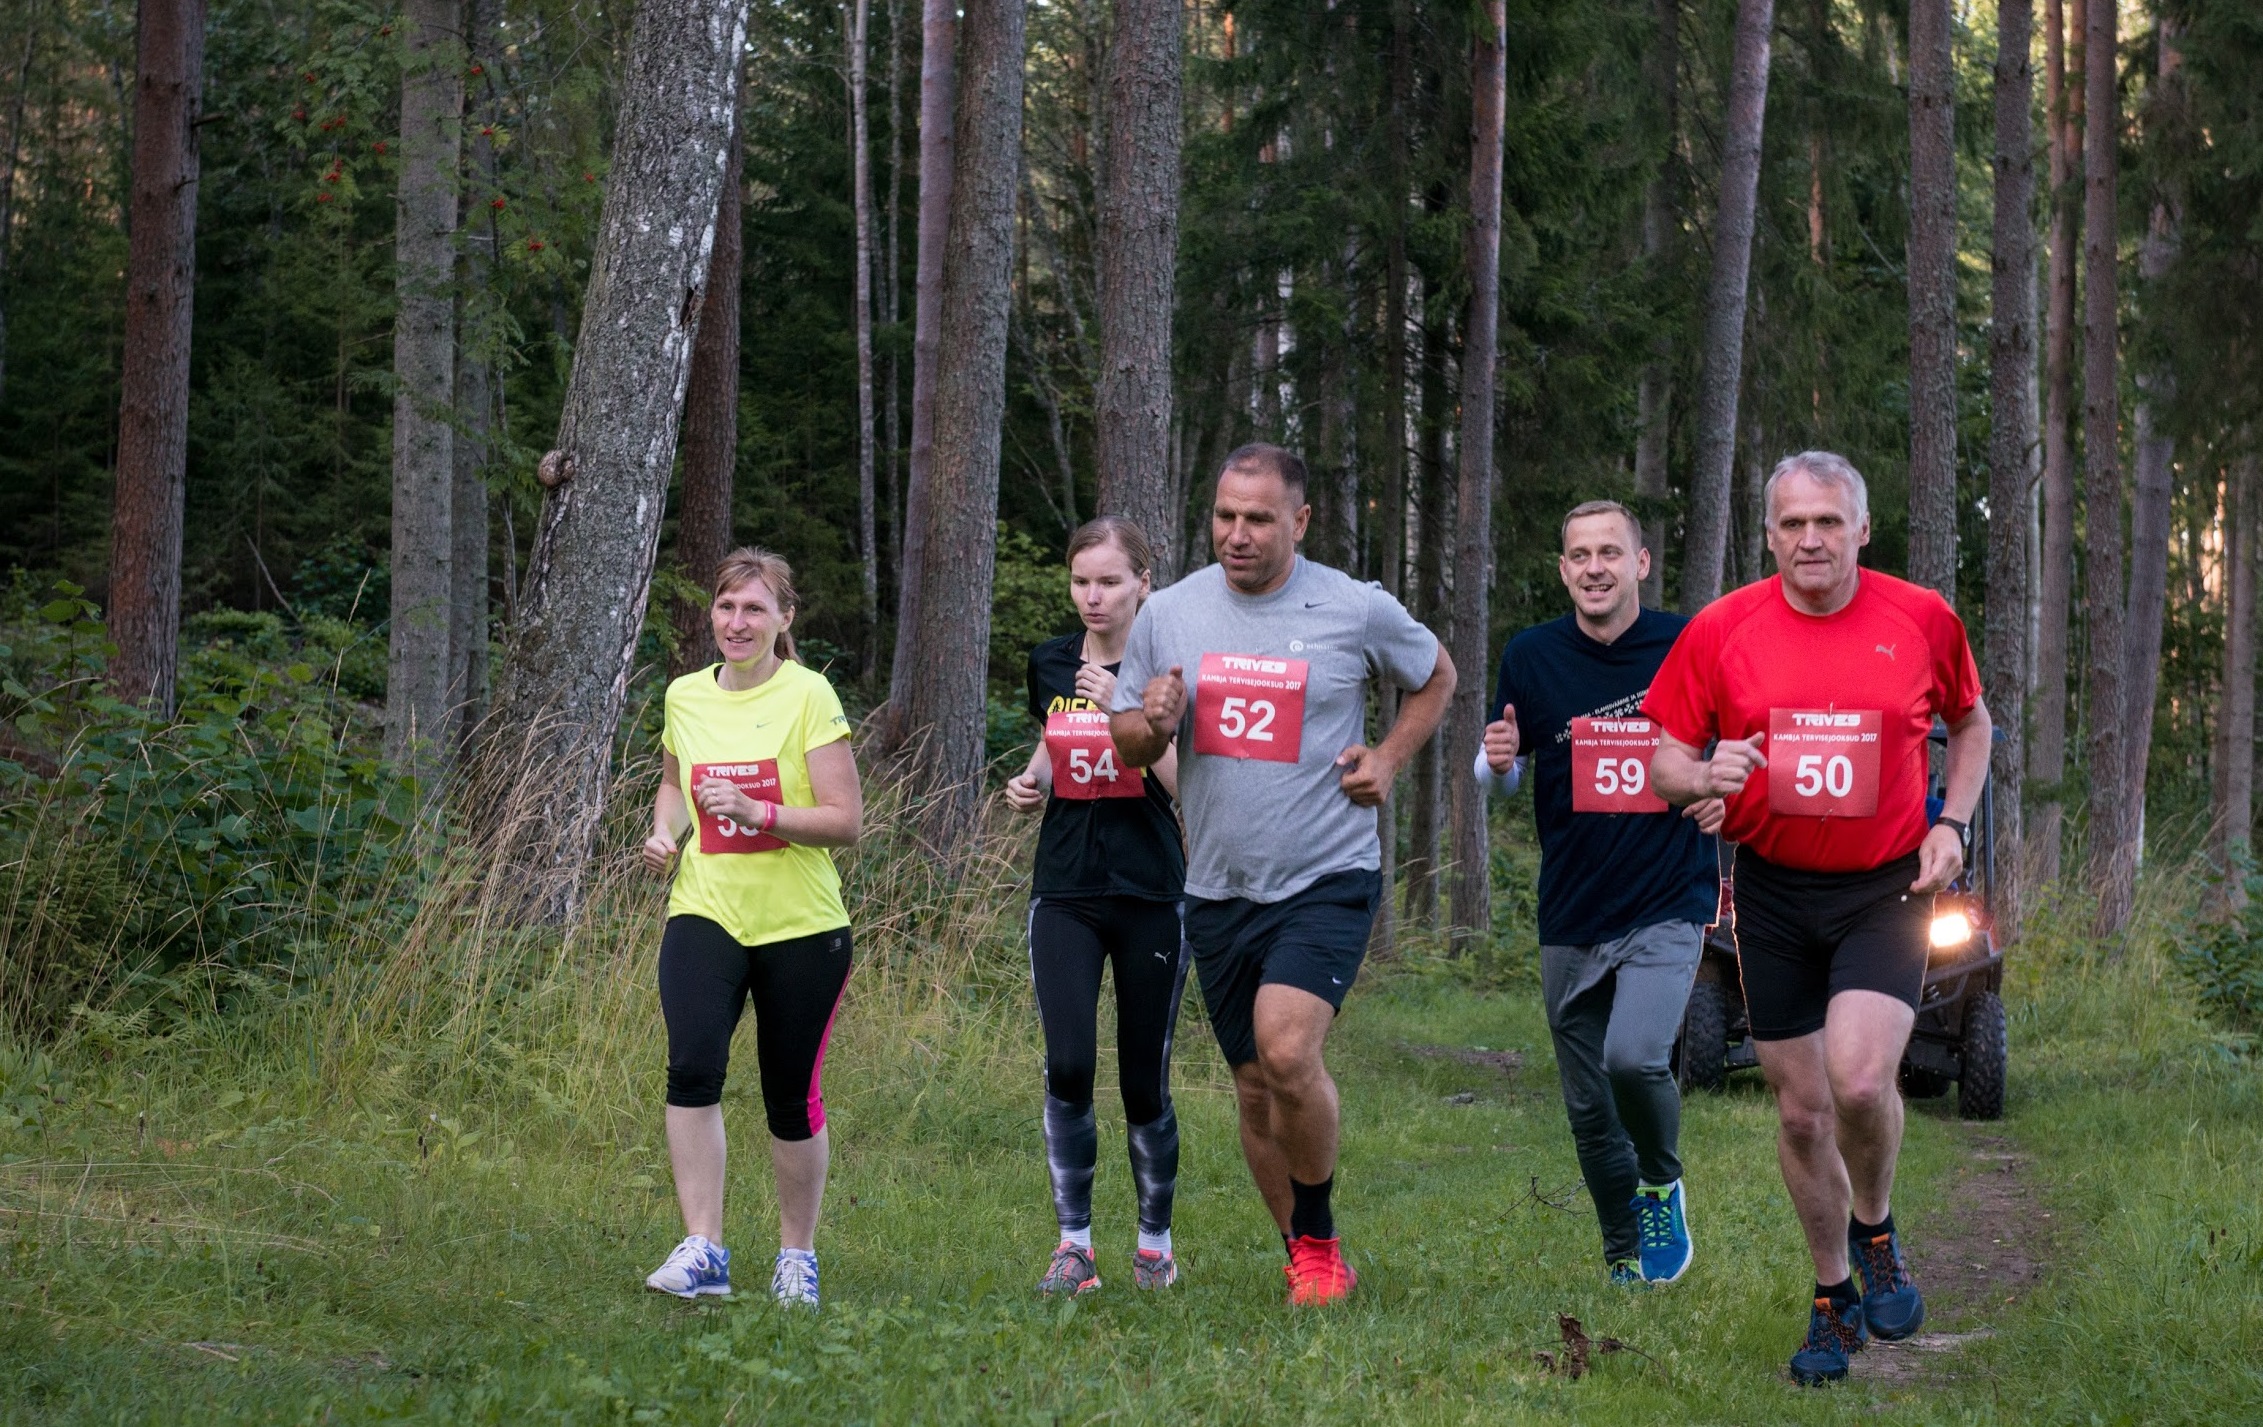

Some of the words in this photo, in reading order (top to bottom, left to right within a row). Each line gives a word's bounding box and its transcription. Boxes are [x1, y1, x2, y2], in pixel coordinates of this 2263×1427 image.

[1222, 656, 1287, 674] TRIVES
[1202, 675, 1227, 684] KAMBJA
[1229, 676, 1284, 689] TERVISEJOOKSUD
[1285, 680, 1302, 691] 2017
[1065, 712, 1110, 724] TRIVE
[1218, 697, 1276, 742] 52
[1792, 713, 1861, 727] TRIVES
[1590, 721, 1651, 733] TRIVES
[1575, 739, 1599, 747] KAMBJA
[1600, 739, 1650, 747] TERVISEJOOKSUD
[1651, 737, 1660, 746] 20
[1773, 733, 1800, 742] KAMBJA
[1802, 733, 1860, 743] TERVISEJOOKSUD
[1861, 733, 1877, 742] 2017
[707, 764, 759, 777] TRIVES
[1069, 748, 1119, 784] 54
[761, 778, 776, 788] 2017
[1594, 757, 1645, 796] 59
[1795, 754, 1853, 798] 50
